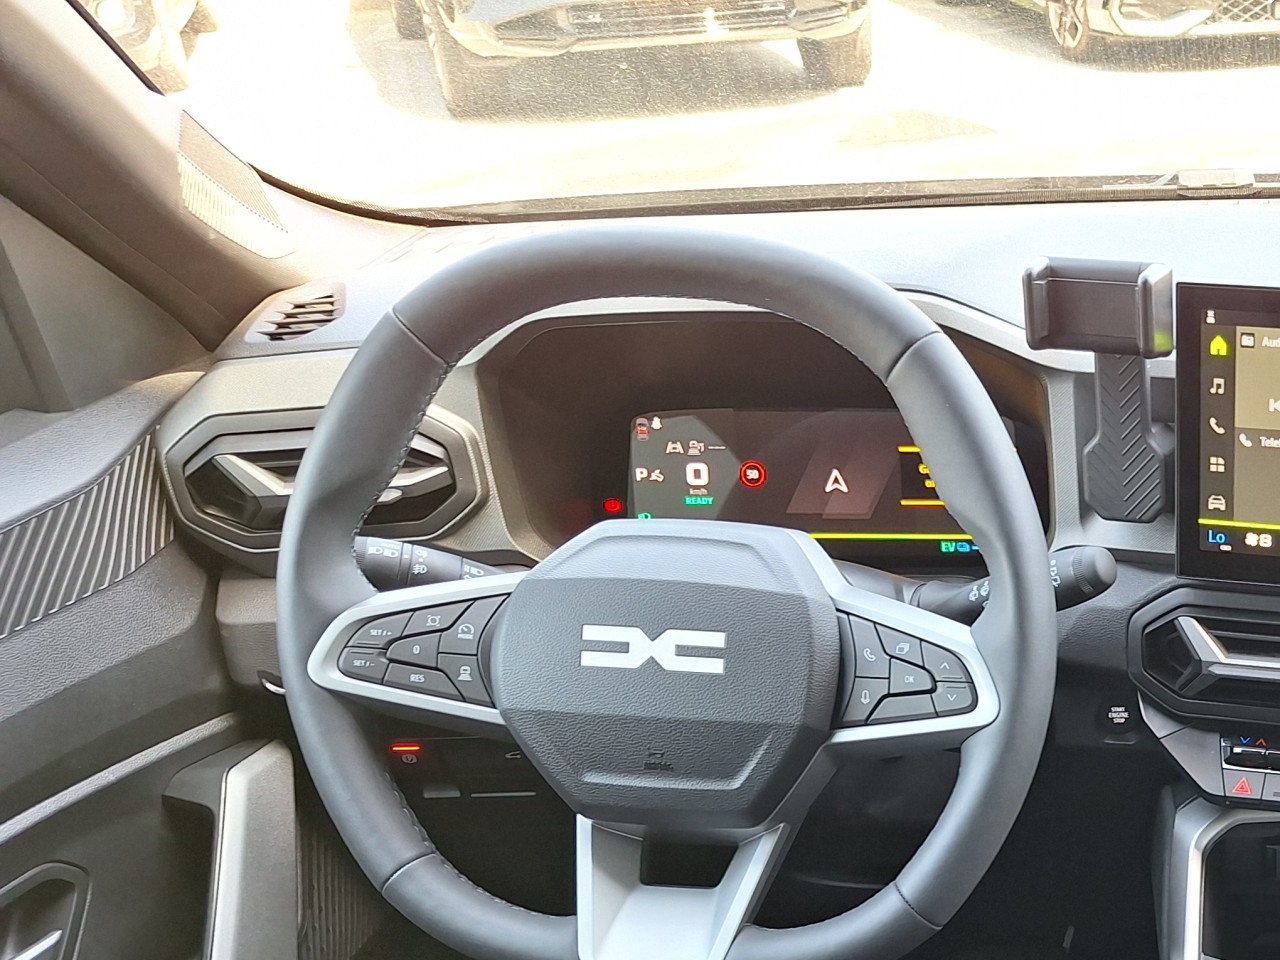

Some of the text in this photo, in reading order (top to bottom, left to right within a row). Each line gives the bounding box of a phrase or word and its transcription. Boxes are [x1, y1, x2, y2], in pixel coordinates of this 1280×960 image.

[635, 467, 648, 482] P
[685, 497, 713, 505] READY
[1208, 530, 1226, 544] Lo
[940, 541, 956, 552] EV
[410, 674, 425, 683] RES
[904, 675, 914, 683] OK
